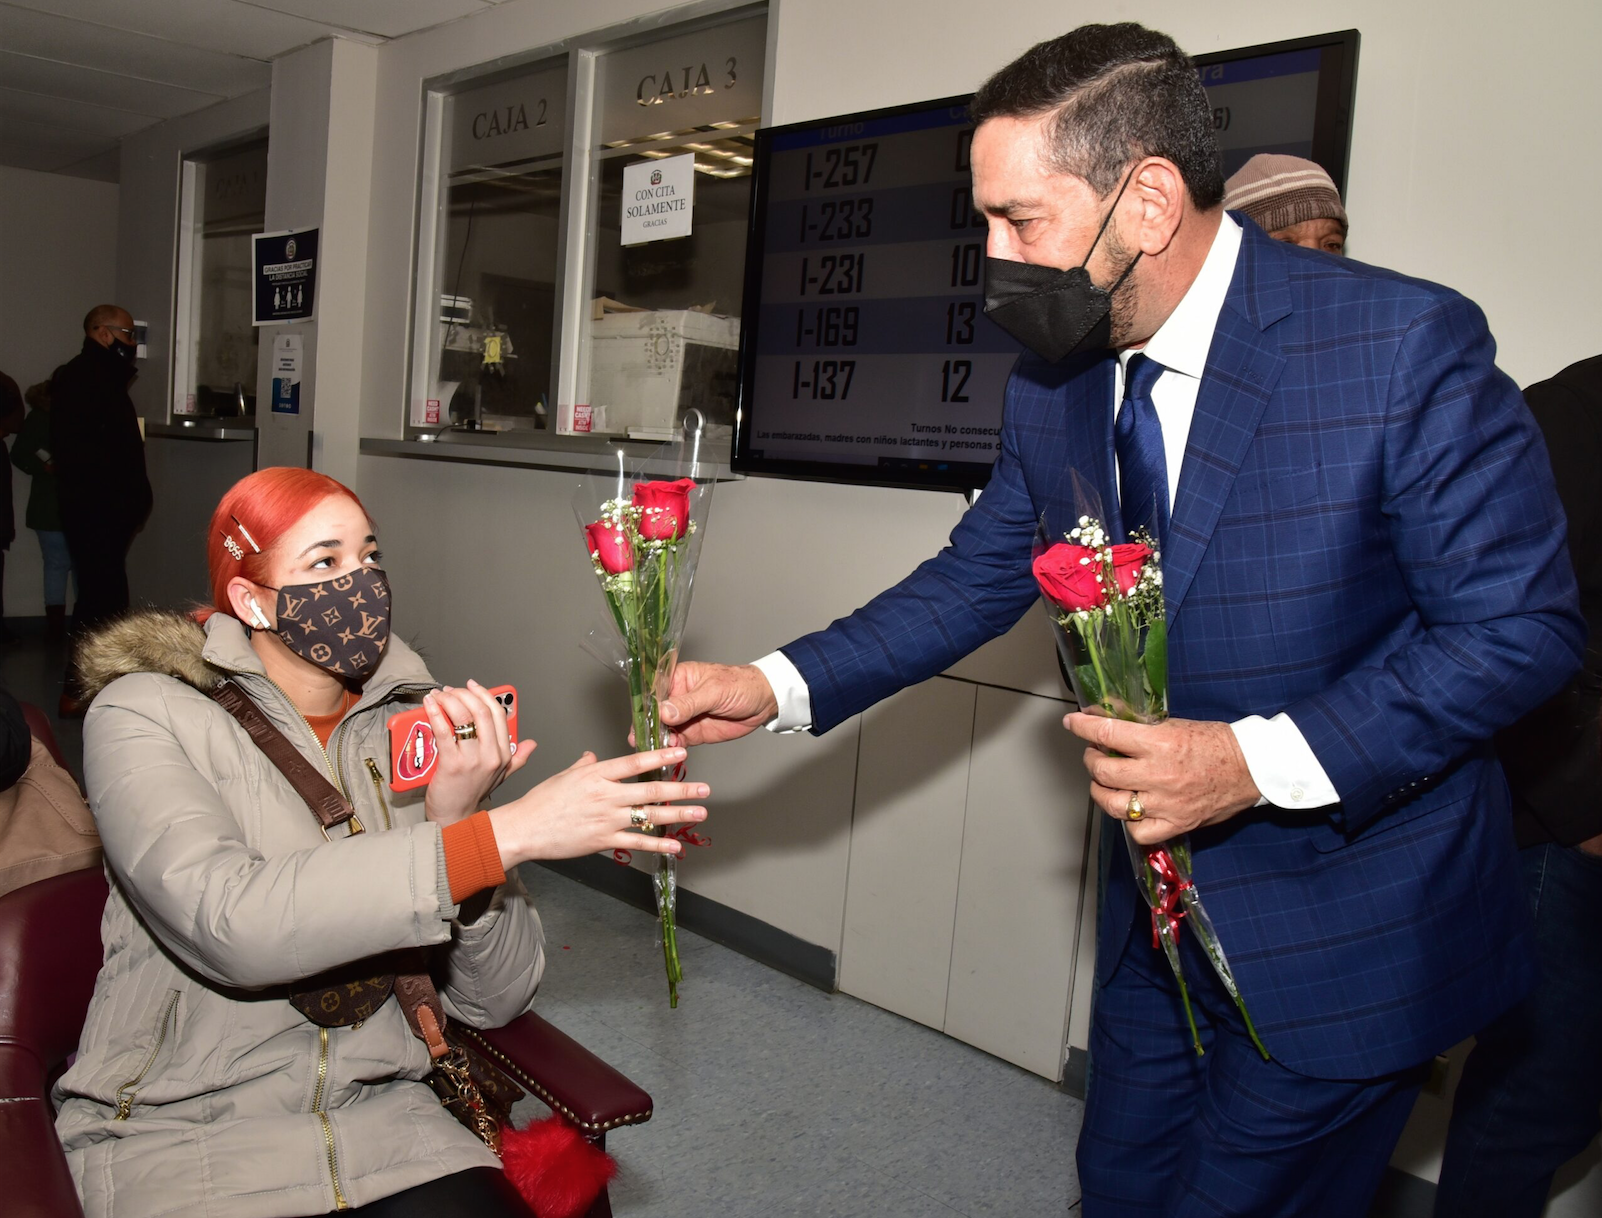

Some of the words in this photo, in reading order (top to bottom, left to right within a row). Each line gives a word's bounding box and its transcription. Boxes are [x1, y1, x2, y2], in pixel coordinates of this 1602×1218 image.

[637, 62, 714, 107] CAJA
[724, 56, 737, 89] 3
[472, 103, 529, 140] CAJA
[536, 98, 547, 127] 2
[804, 143, 879, 191] I-257
[635, 188, 654, 201] CON
[655, 185, 676, 198] CITA
[626, 198, 686, 219] SOLAMENTE
[800, 198, 874, 243] I-233
[642, 218, 668, 228] GRACIAS
[264, 264, 284, 274] GRACIAS
[284, 263, 292, 271] POR
[292, 260, 312, 269] PRACTICAR
[275, 272, 295, 281] DISTANCIA
[295, 270, 308, 278] SOCIAL
[800, 253, 864, 296] I-231
[951, 243, 981, 287] 10
[796, 306, 860, 347] I-169
[946, 302, 977, 344] 13
[793, 361, 856, 400] I-137
[941, 360, 972, 403] 12
[756, 430, 769, 439] Las
[771, 431, 823, 443] embarazadas,
[825, 433, 854, 443] madres
[855, 436, 871, 444] con
[873, 435, 897, 445] niños
[900, 436, 939, 447] lactantes
[941, 439, 947, 450] y
[949, 439, 992, 450] personas
[911, 423, 942, 434] Turnos
[944, 424, 957, 434] No
[223, 535, 243, 561] BOSS
